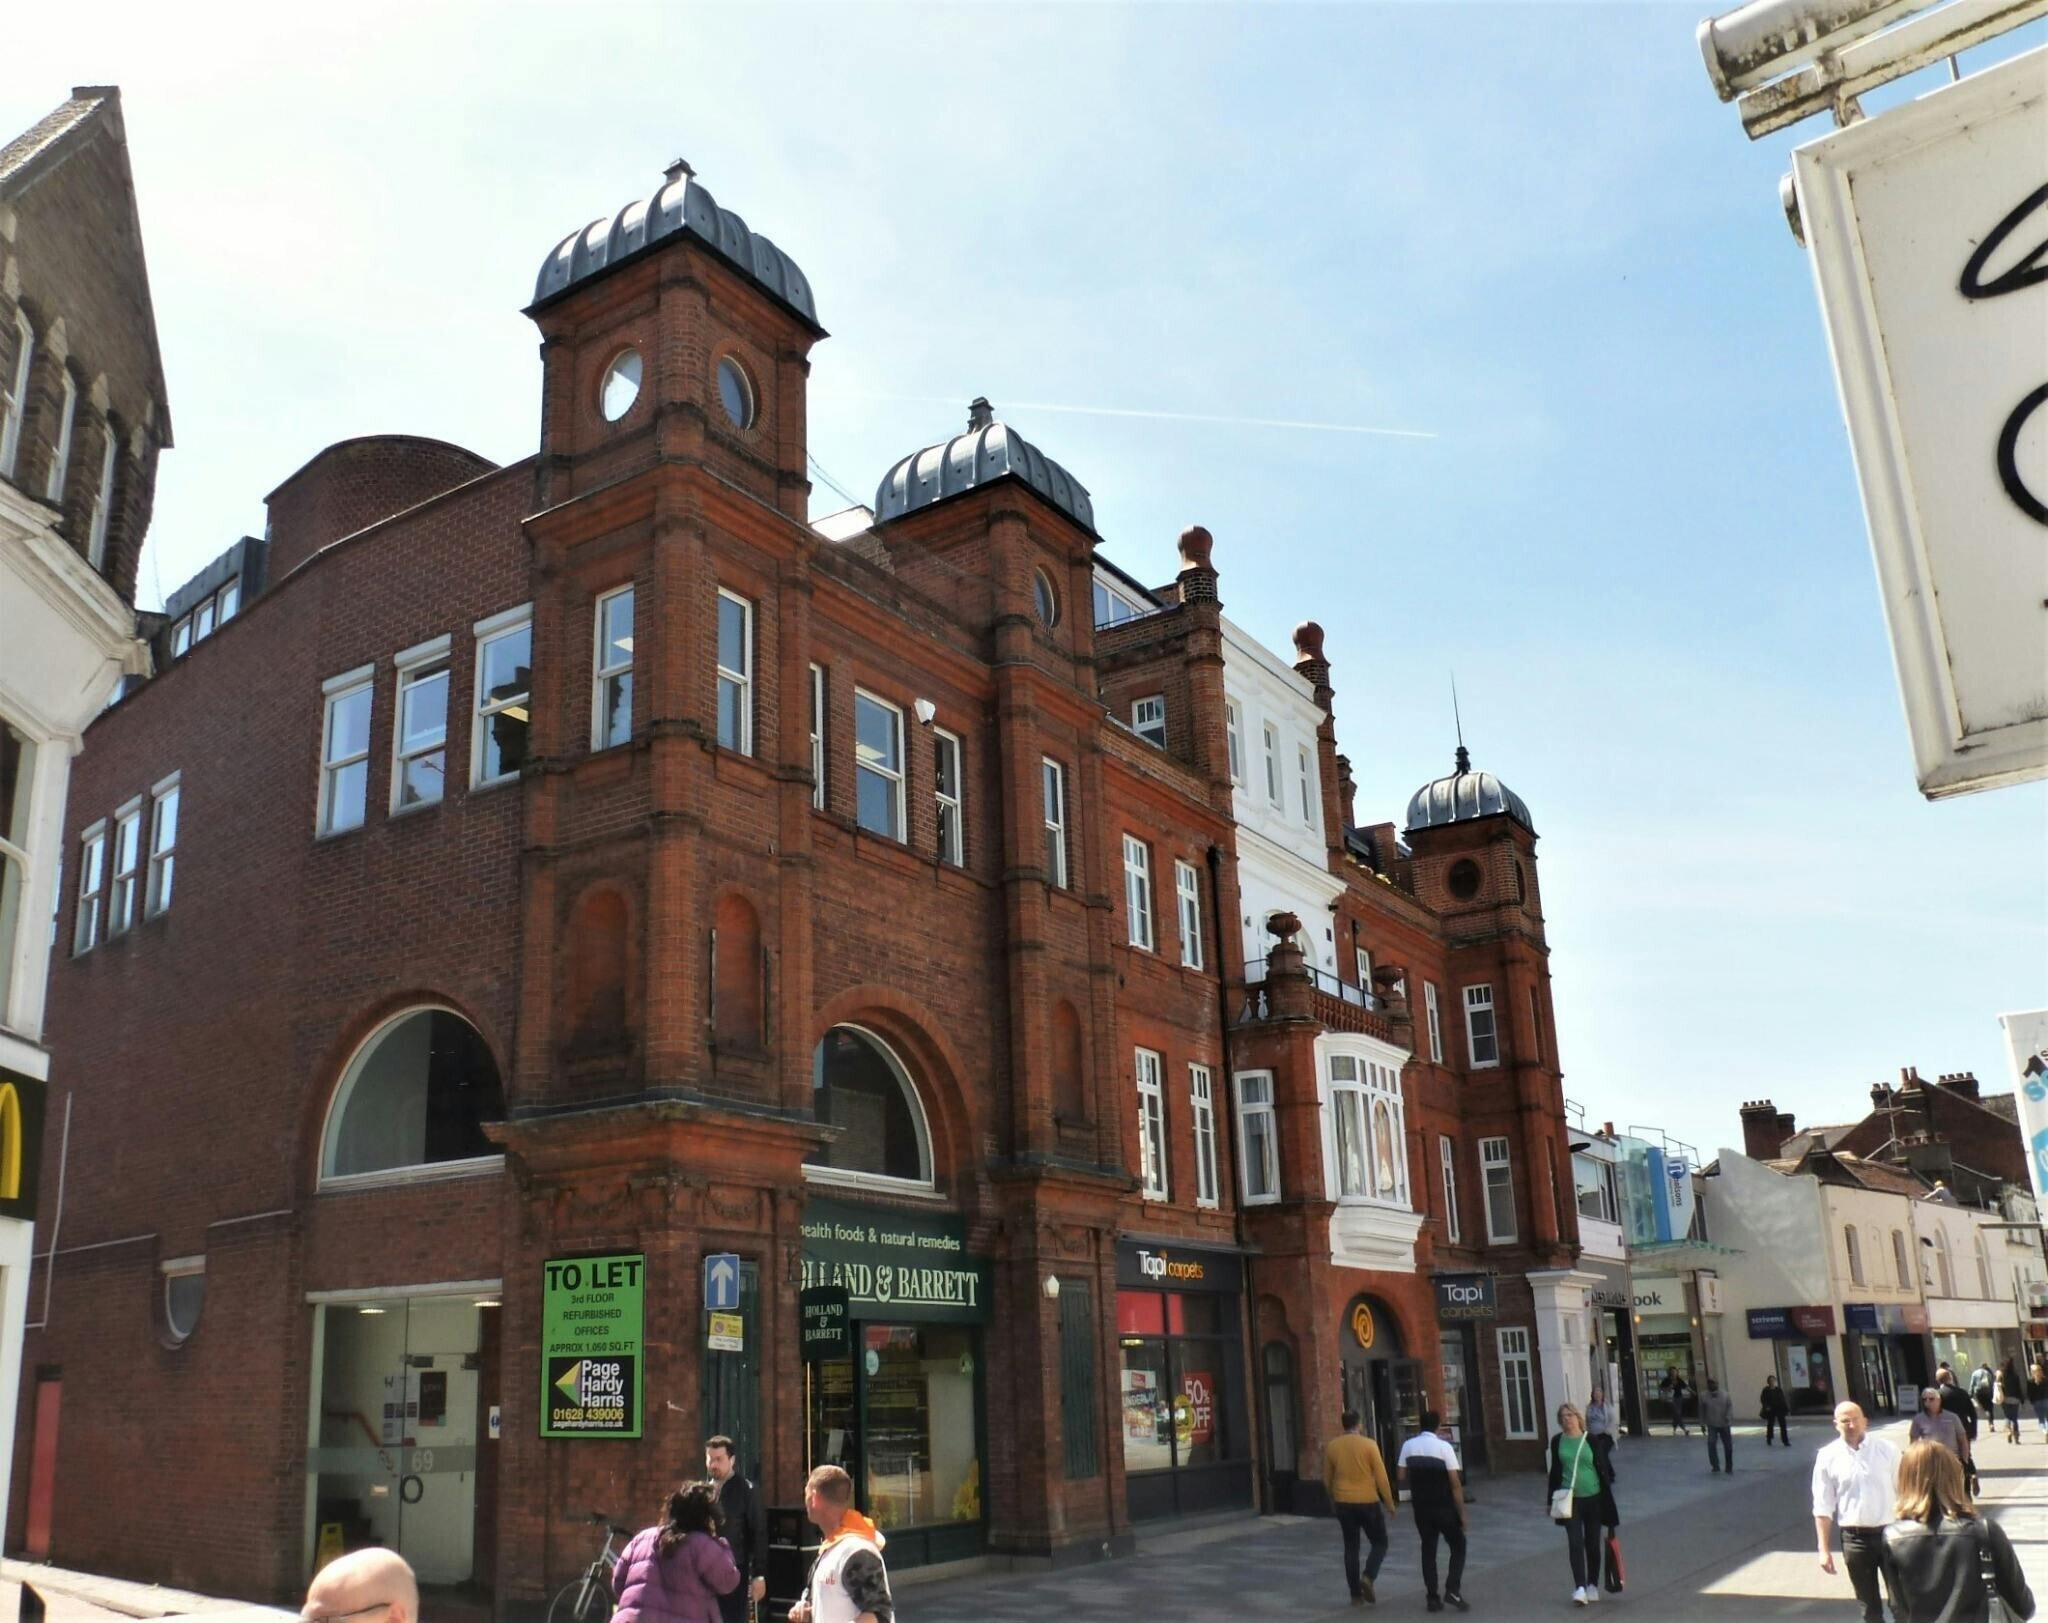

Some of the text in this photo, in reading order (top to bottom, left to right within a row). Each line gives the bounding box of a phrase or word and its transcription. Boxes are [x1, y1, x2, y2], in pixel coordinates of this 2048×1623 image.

[835, 1224, 864, 1242] foods
[868, 1227, 877, 1243] &
[880, 1232, 915, 1246] natural
[918, 1235, 960, 1251] remedies
[1137, 1250, 1204, 1281] Tapi carpets
[546, 1260, 642, 1291] TO LET
[875, 1265, 893, 1303] &
[898, 1267, 978, 1306] BARRETT
[1441, 1280, 1484, 1305] Tapi
[571, 1292, 614, 1304] 3rd FLOOR
[563, 1309, 622, 1320] REFURBISHED
[805, 1303, 843, 1319] HOLLAND
[574, 1325, 610, 1336] OFFICES
[820, 1316, 828, 1328] &
[805, 1328, 842, 1341] BARRETT
[549, 1342, 583, 1353] APPROX
[582, 1359, 620, 1380] Page
[581, 1376, 624, 1395] Hardy
[1184, 1379, 1210, 1405] 50%
[581, 1391, 624, 1408] Harris
[553, 1408, 625, 1420] 01628 439006
